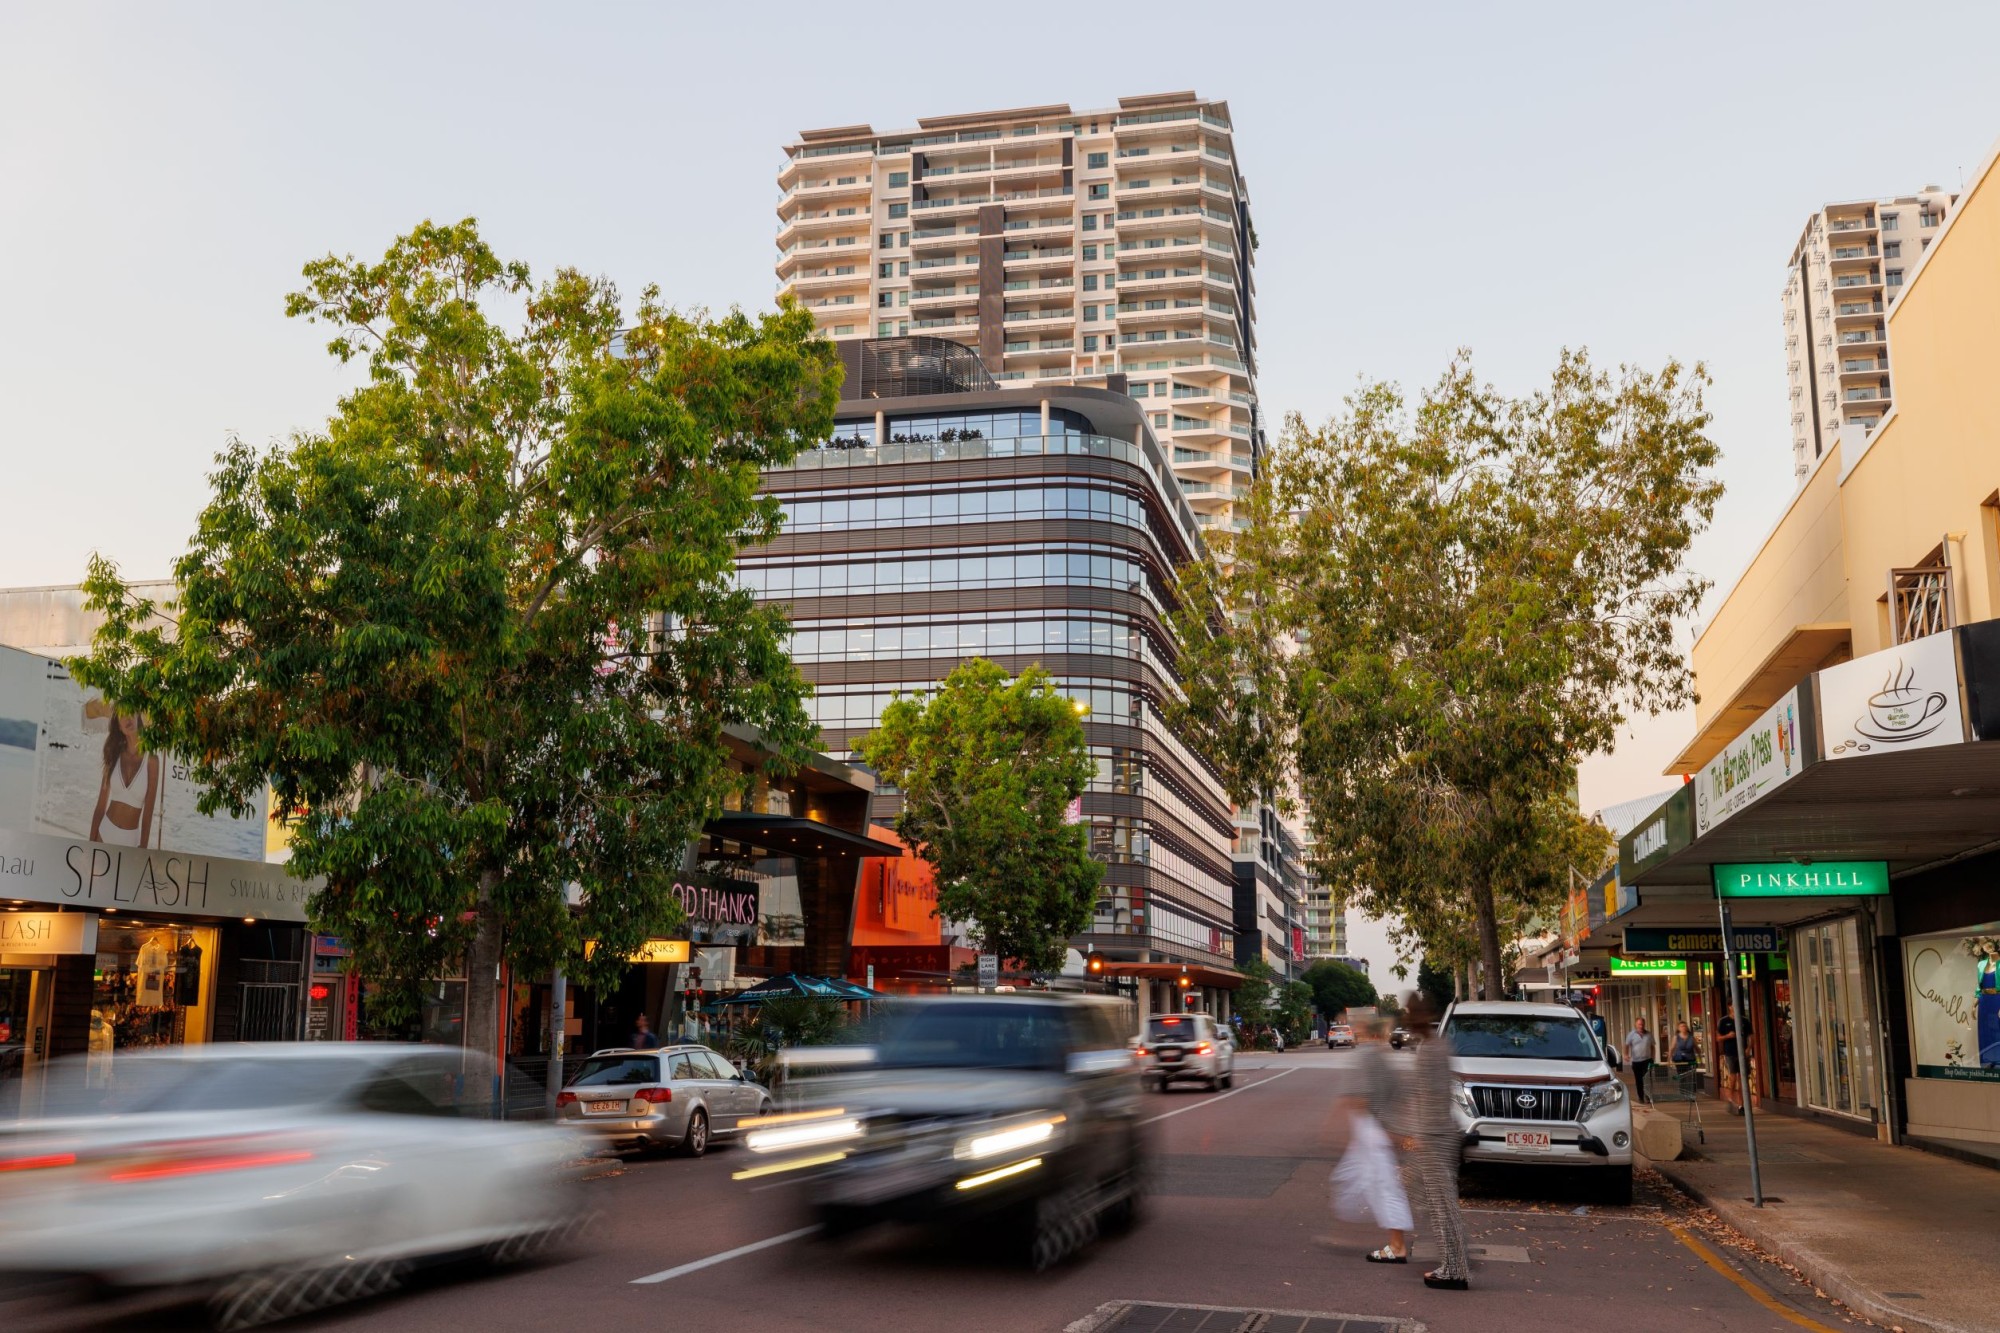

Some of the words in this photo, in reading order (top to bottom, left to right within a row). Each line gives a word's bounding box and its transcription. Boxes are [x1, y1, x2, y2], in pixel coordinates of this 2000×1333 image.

[1711, 766, 1723, 804] The
[1751, 728, 1772, 774] Press
[61, 845, 209, 908] SPLASH
[229, 878, 270, 900] SWIM
[276, 885, 285, 901] &
[1741, 872, 1863, 887] PINKHILL
[701, 887, 755, 925] THANKS
[1507, 1133, 1519, 1143] CC
[1522, 1134, 1534, 1144] 90
[1536, 1134, 1549, 1145] ZA
